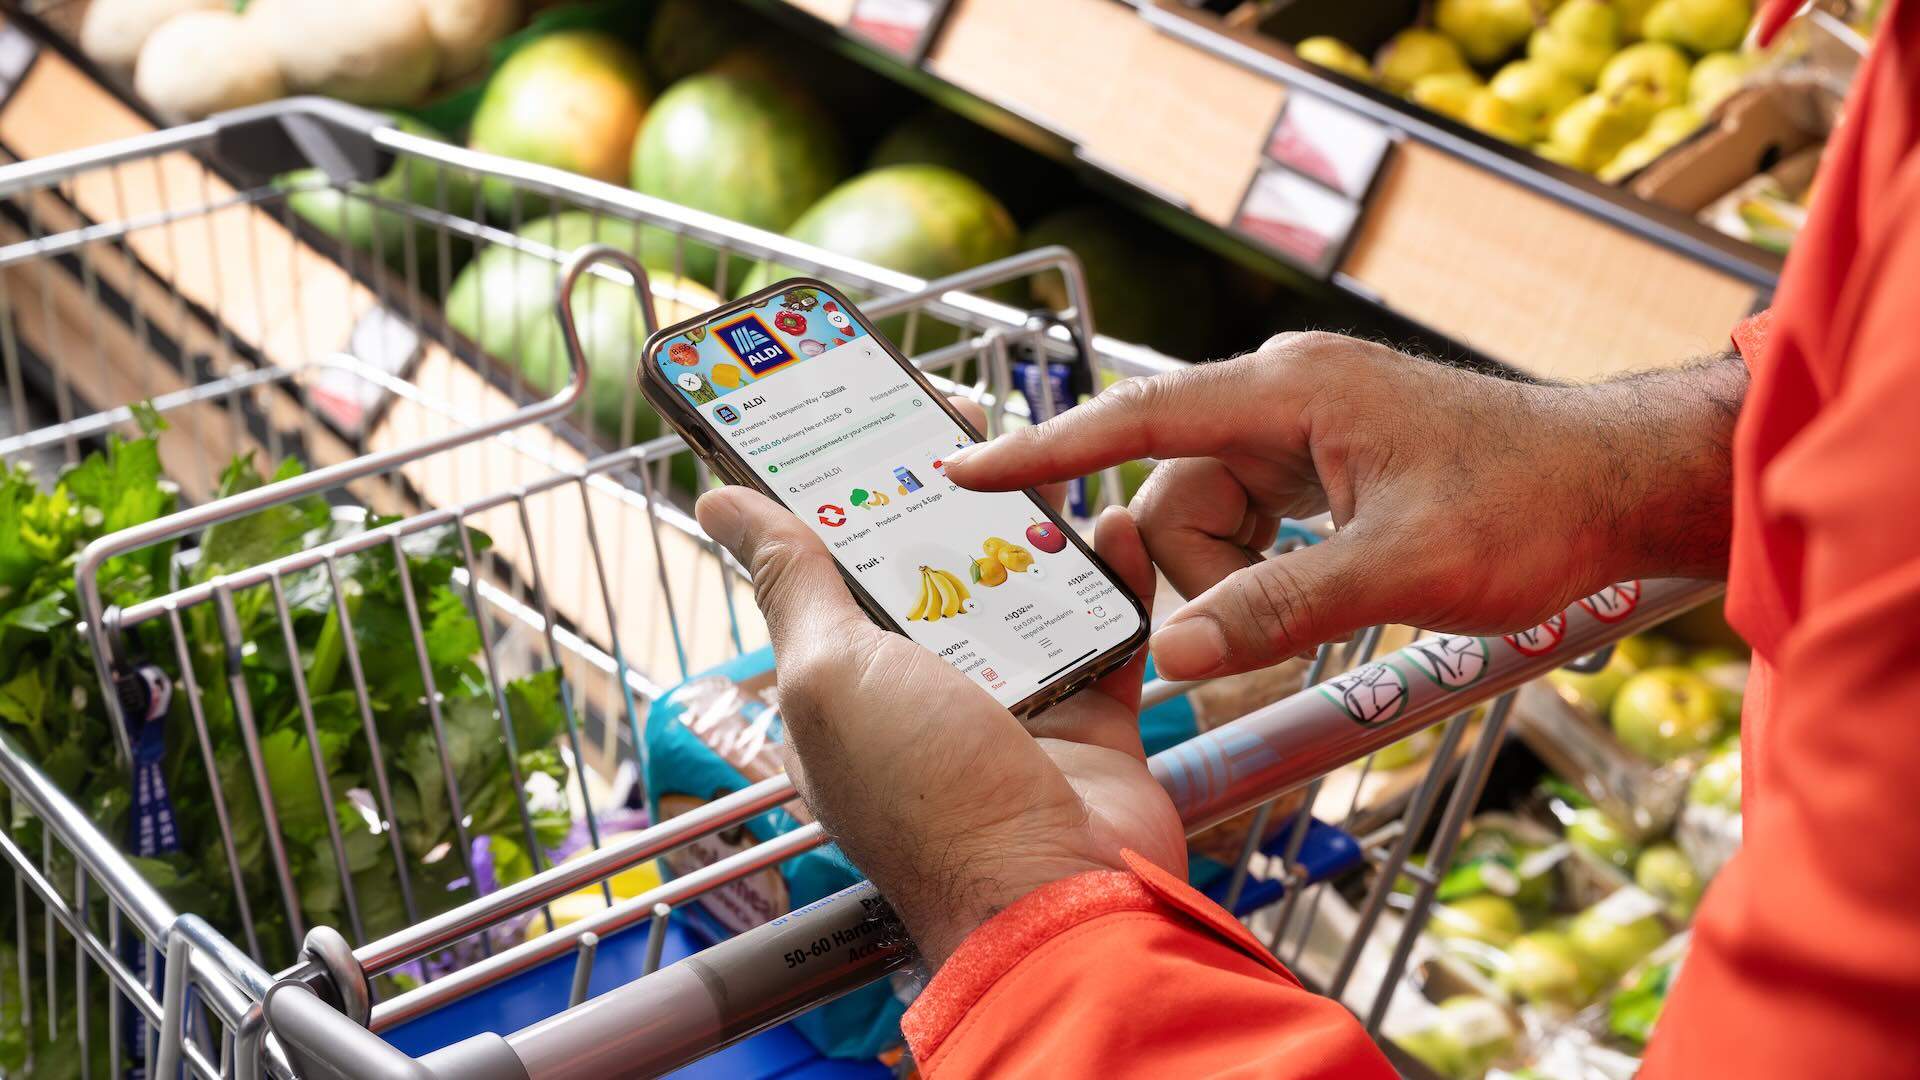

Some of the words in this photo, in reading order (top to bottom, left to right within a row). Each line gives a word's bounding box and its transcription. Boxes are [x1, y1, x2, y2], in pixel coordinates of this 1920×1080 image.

[748, 344, 783, 366] ALDI
[731, 428, 746, 438] 400
[746, 419, 767, 432] metres
[777, 402, 805, 418] Benjamin
[804, 396, 819, 408] Way
[821, 385, 846, 399] Change
[743, 395, 767, 411] ALDI
[779, 451, 810, 469] Freshness
[809, 436, 843, 456] guaranteed
[849, 427, 861, 438] your
[862, 419, 882, 431] money
[881, 412, 896, 422] back
[781, 429, 806, 443] delivery
[804, 424, 815, 433] fee
[814, 419, 824, 428] on
[740, 440, 747, 448] 19
[748, 436, 761, 446] min
[800, 475, 824, 490] Search
[823, 466, 842, 479] ALDI
[906, 501, 923, 513] Dairy
[927, 493, 943, 504] Eggs
[875, 513, 902, 528] Produce
[834, 539, 848, 550] Buy
[852, 528, 871, 541] Again
[855, 556, 880, 573] Fruit
[1076, 588, 1086, 597] Est
[1013, 624, 1024, 632] Est
[1034, 613, 1043, 622] kg
[1021, 626, 1046, 640] Imperial
[1044, 608, 1074, 627] Mandarins
[1094, 623, 1106, 632] Buy
[1109, 613, 1124, 624] Again
[967, 651, 976, 659] kg
[1048, 647, 1064, 658] Aisles
[961, 656, 988, 674] vendish
[991, 680, 1007, 691] Store
[784, 937, 831, 969] 50-60
